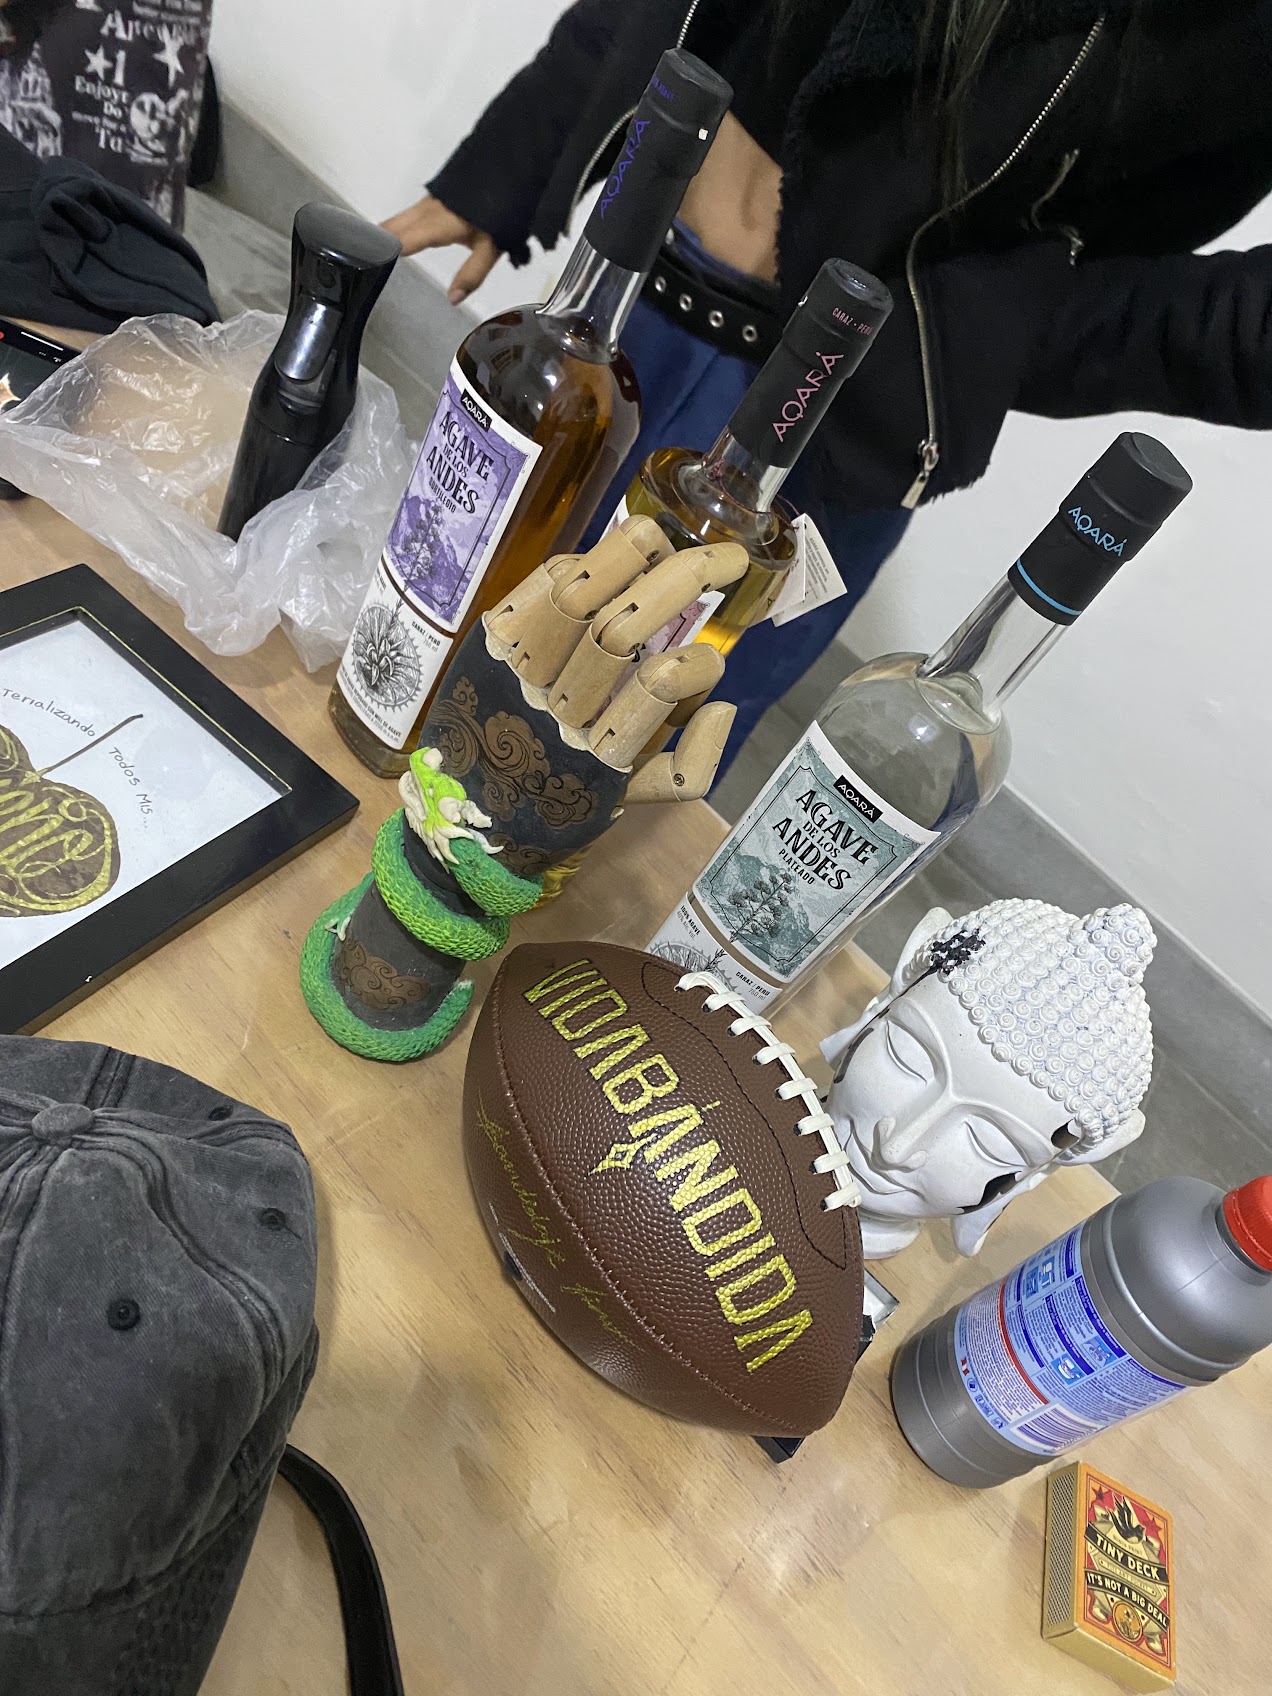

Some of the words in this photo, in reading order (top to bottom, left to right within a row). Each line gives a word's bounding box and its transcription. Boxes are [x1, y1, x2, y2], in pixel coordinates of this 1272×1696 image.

[832, 307, 854, 326] CARAZ
[772, 351, 845, 442] AQARÁ
[439, 410, 495, 481] AGAVE
[442, 443, 453, 459] DE
[451, 455, 469, 478] LOS
[426, 445, 481, 515] ANDES
[1067, 506, 1128, 557] AQARÁ
[837, 782, 876, 820] AQARÁ
[795, 788, 879, 866] AGAVE
[802, 822, 820, 840] DE
[816, 834, 841, 859] LOS
[772, 816, 853, 892] ANDES
[778, 848, 817, 886] PLATEADO
[688, 918, 700, 936] AGAVE
[735, 971, 753, 985] CARAZ
[1096, 1533, 1124, 1562] TINY
[1127, 1555, 1160, 1581] DECK
[1086, 1572, 1103, 1587] IT'S
[1103, 1577, 1122, 1593] NOT
[1123, 1587, 1130, 1598] A
[1130, 1589, 1146, 1608] BIG
[1147, 1602, 1168, 1627] DEAL
